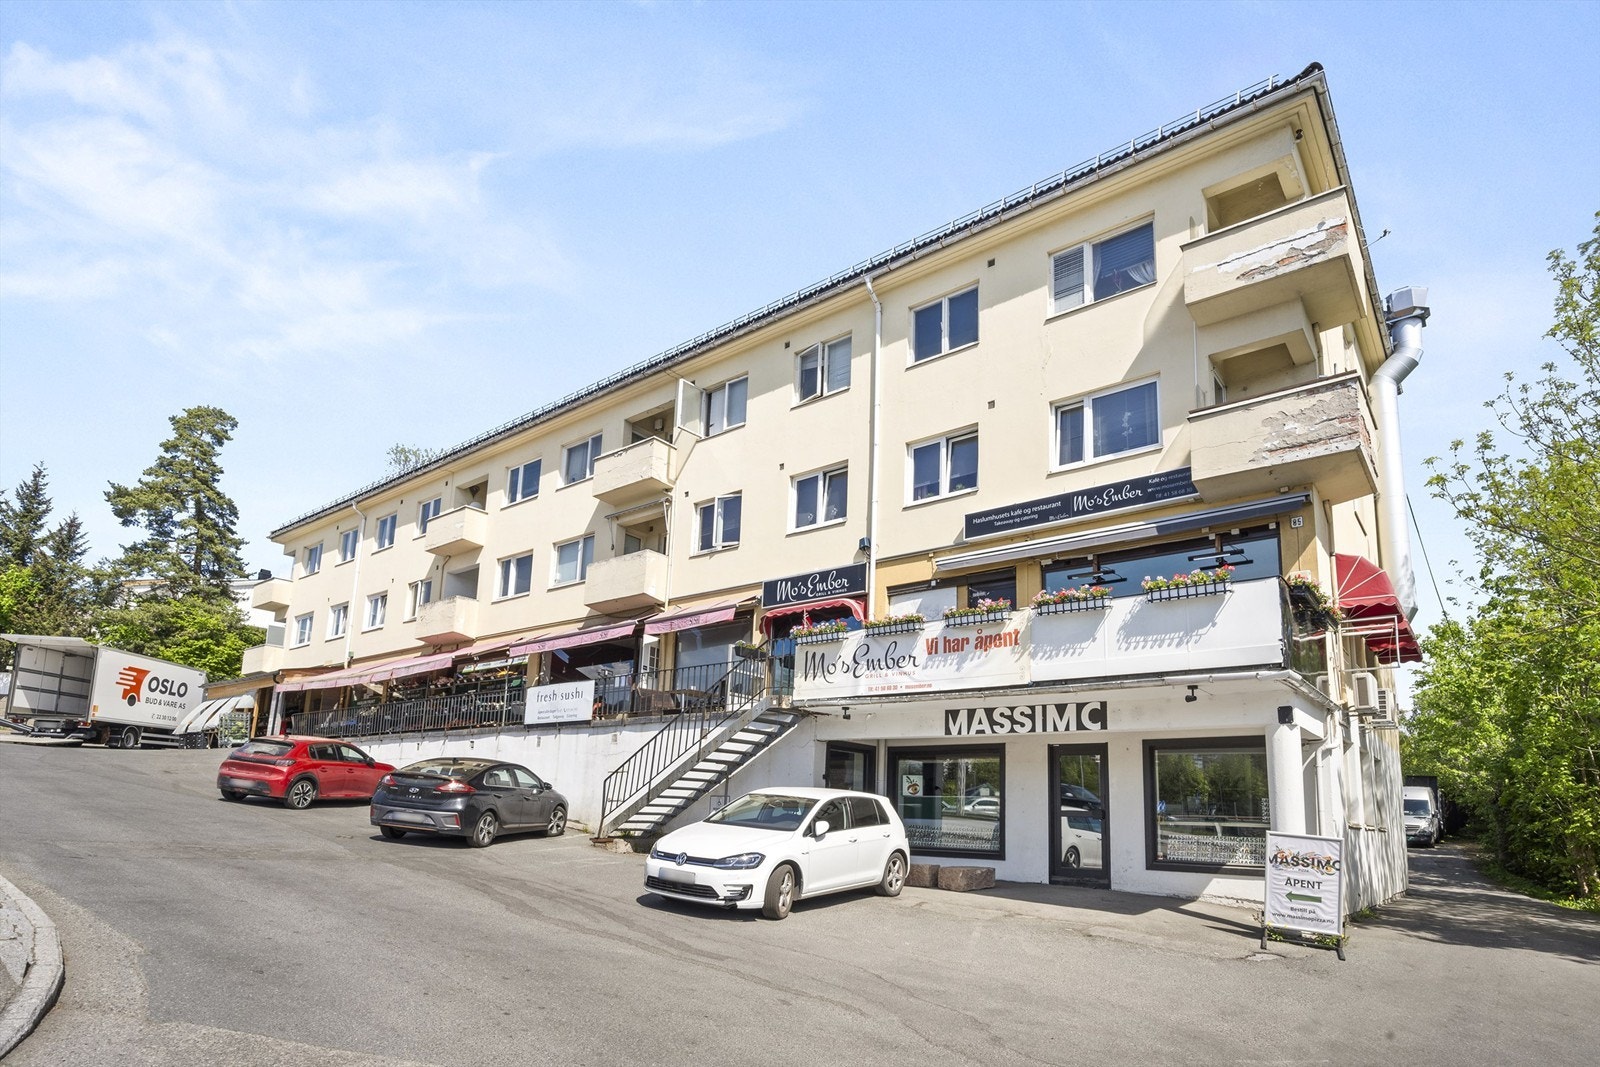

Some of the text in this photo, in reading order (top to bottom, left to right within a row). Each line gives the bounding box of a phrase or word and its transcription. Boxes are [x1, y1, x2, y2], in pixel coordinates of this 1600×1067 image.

[1103, 485, 1143, 506] Ember
[972, 512, 1010, 524] Haslumhusets
[1010, 508, 1022, 518] kafé
[1031, 501, 1061, 512] restaurant
[807, 570, 849, 597] Ember
[926, 629, 1020, 655] Vi har åpent
[853, 641, 920, 678] Ember
[148, 676, 188, 698] OSLO
[536, 687, 583, 702] fresh sushi
[145, 697, 158, 705] BUD
[1272, 912, 1334, 924] www.massimopizza.no
